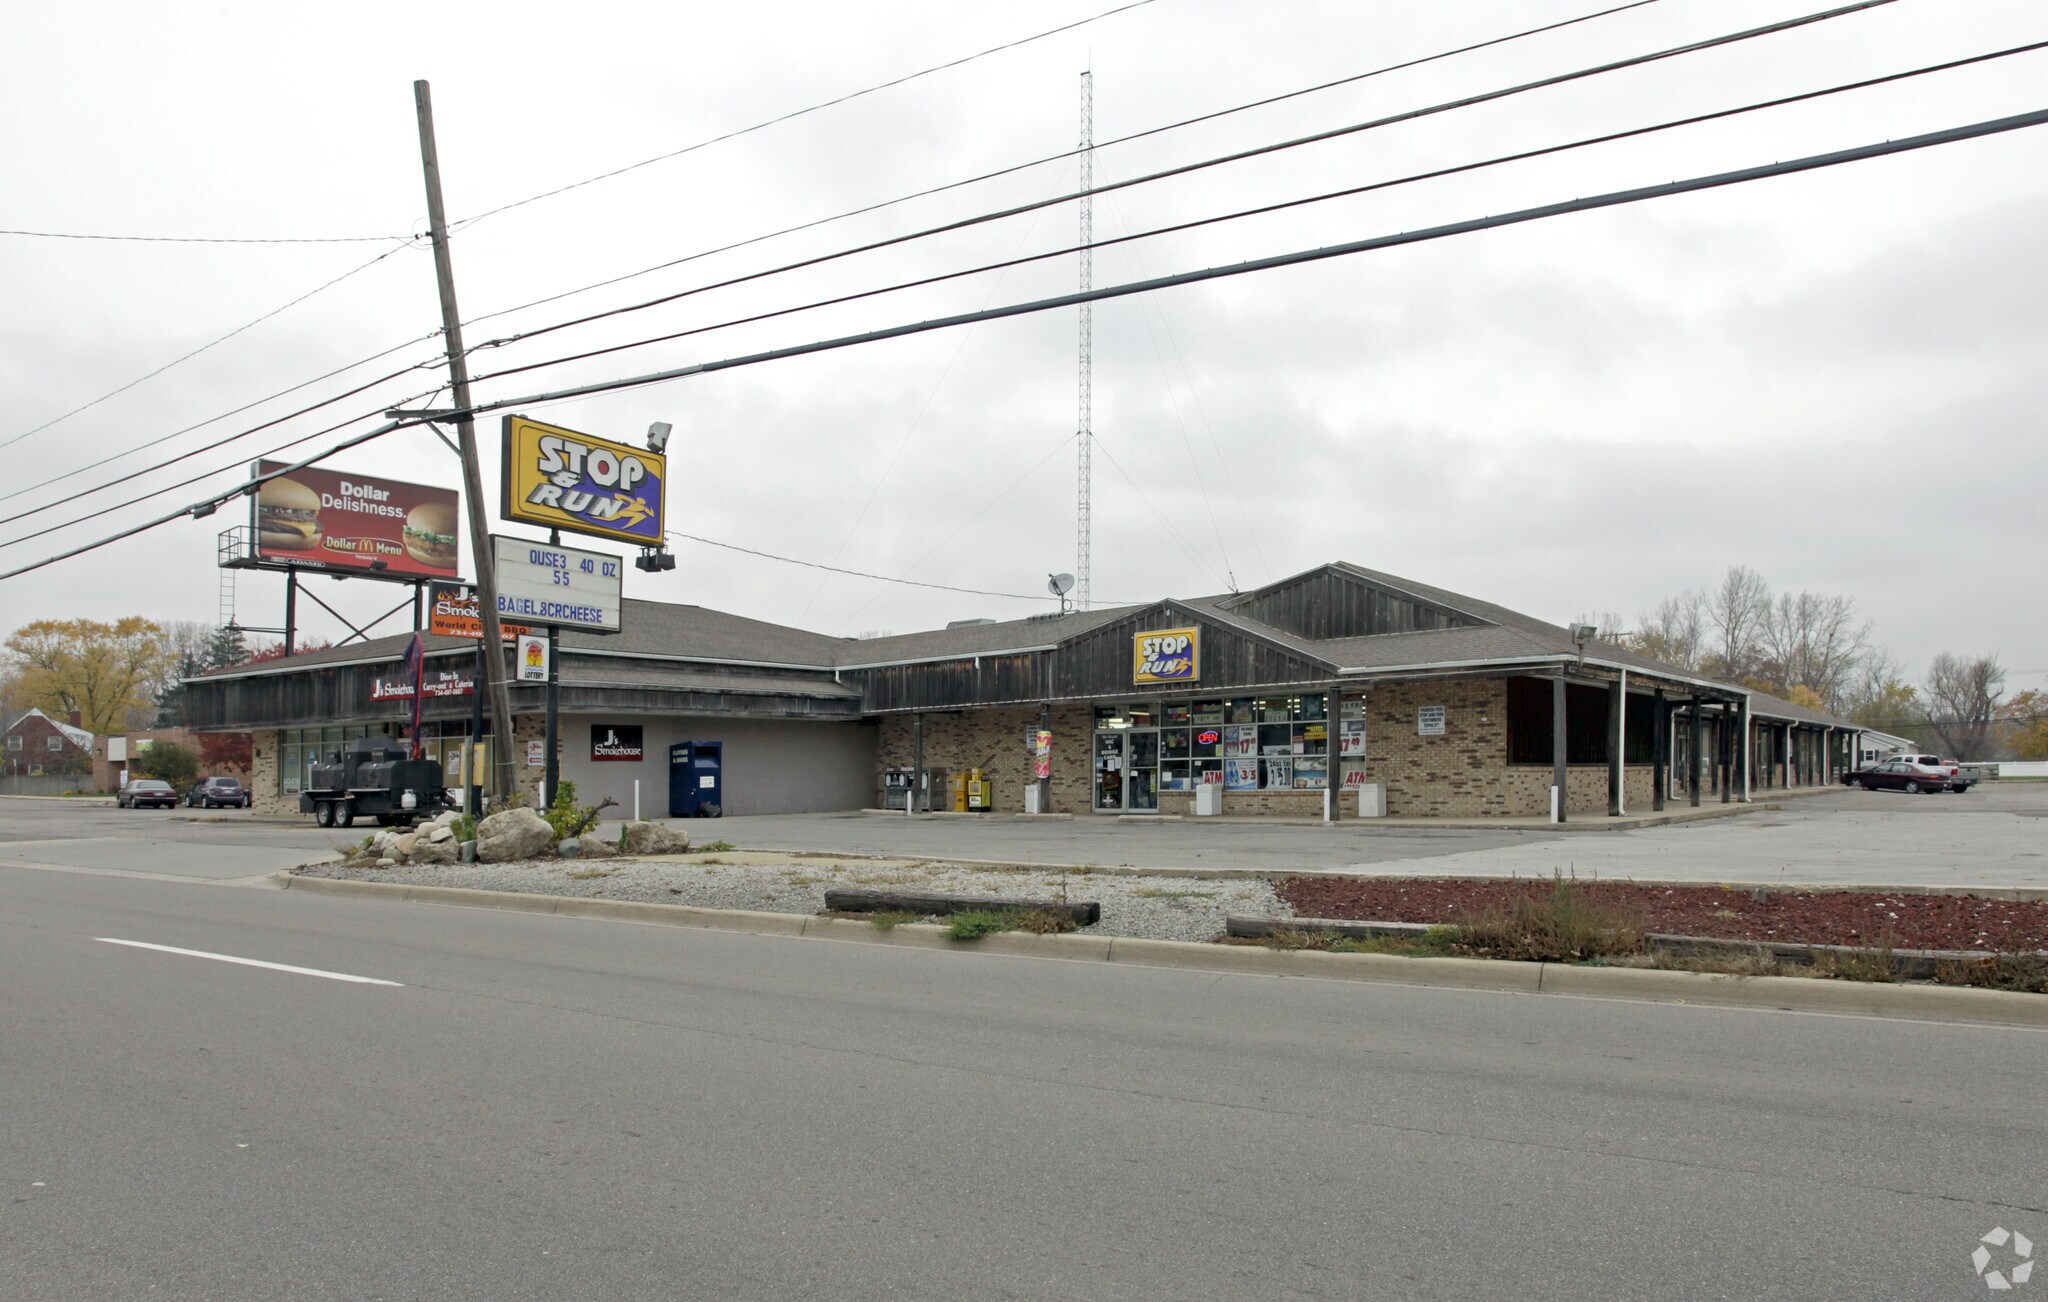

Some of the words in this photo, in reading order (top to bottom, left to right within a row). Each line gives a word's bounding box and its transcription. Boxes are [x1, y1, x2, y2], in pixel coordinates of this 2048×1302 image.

[538, 435, 644, 491] STOP
[340, 481, 390, 502] Dollar
[322, 493, 407, 518] Delishness.
[526, 482, 625, 518] RUN
[326, 536, 356, 550] Dollar
[376, 542, 402, 556] Menu
[289, 558, 324, 568] ADAMS
[530, 549, 566, 568] OUSE3
[580, 558, 594, 574] 40
[602, 562, 616, 577] OZ
[455, 586, 480, 602] J's
[437, 600, 480, 618] Smok
[435, 620, 466, 630] World
[504, 626, 526, 635] BBQ
[1142, 636, 1188, 656] STOP
[1138, 660, 1176, 674] RUN
[440, 672, 452, 682] Dine
[524, 672, 544, 680] LOTTERY
[384, 682, 415, 697] Smokehou
[422, 682, 446, 692] Carry-out
[454, 680, 474, 688] Caterin
[604, 730, 618, 746] J's
[1198, 733, 1218, 742] OPEN
[594, 744, 642, 756] Smokehouse
[1204, 771, 1222, 784] ATM
